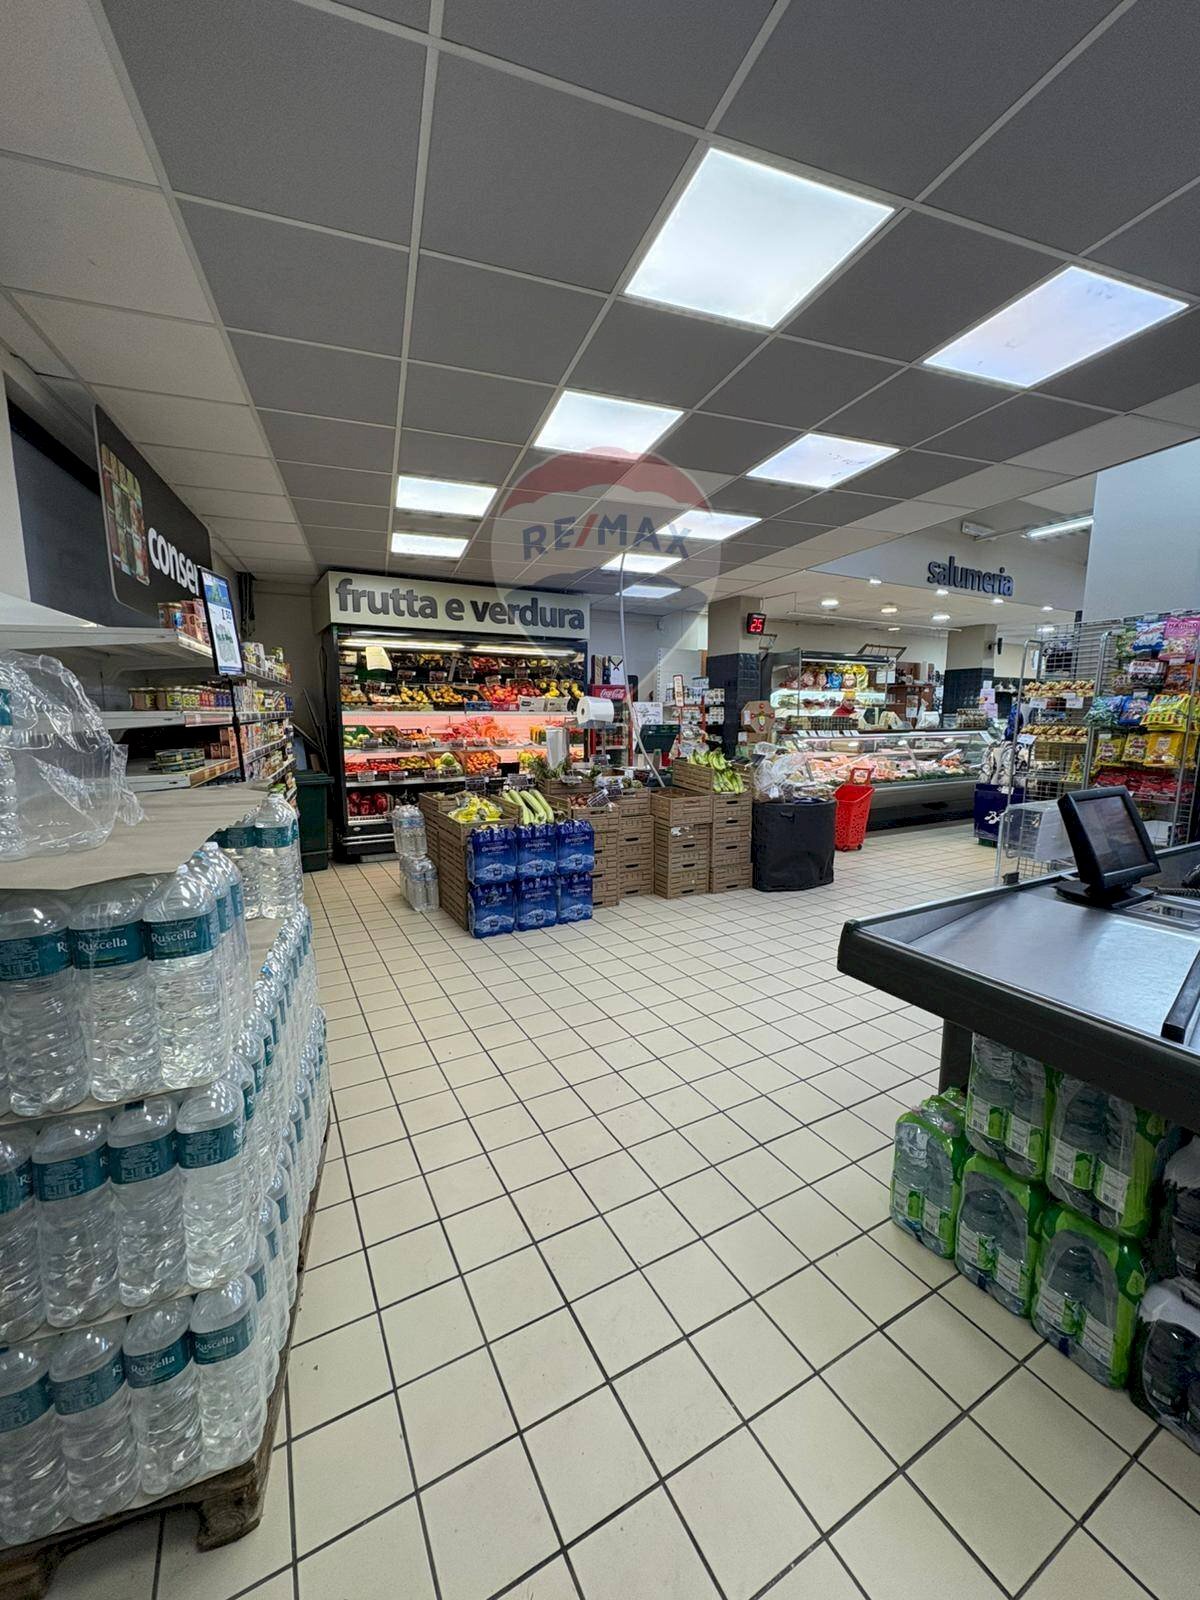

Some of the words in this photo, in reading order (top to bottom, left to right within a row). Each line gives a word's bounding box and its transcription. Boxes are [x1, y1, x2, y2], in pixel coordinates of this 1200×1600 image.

[927, 555, 1014, 597] salumeria
[335, 578, 438, 620] frutta
[445, 598, 465, 621] e
[470, 597, 585, 630] verdura
[750, 618, 763, 632] 25
[77, 937, 128, 955] Ruscella
[150, 930, 197, 946] Ruscella
[195, 1335, 235, 1354] Ruscella
[130, 1355, 176, 1376] Ruscella
